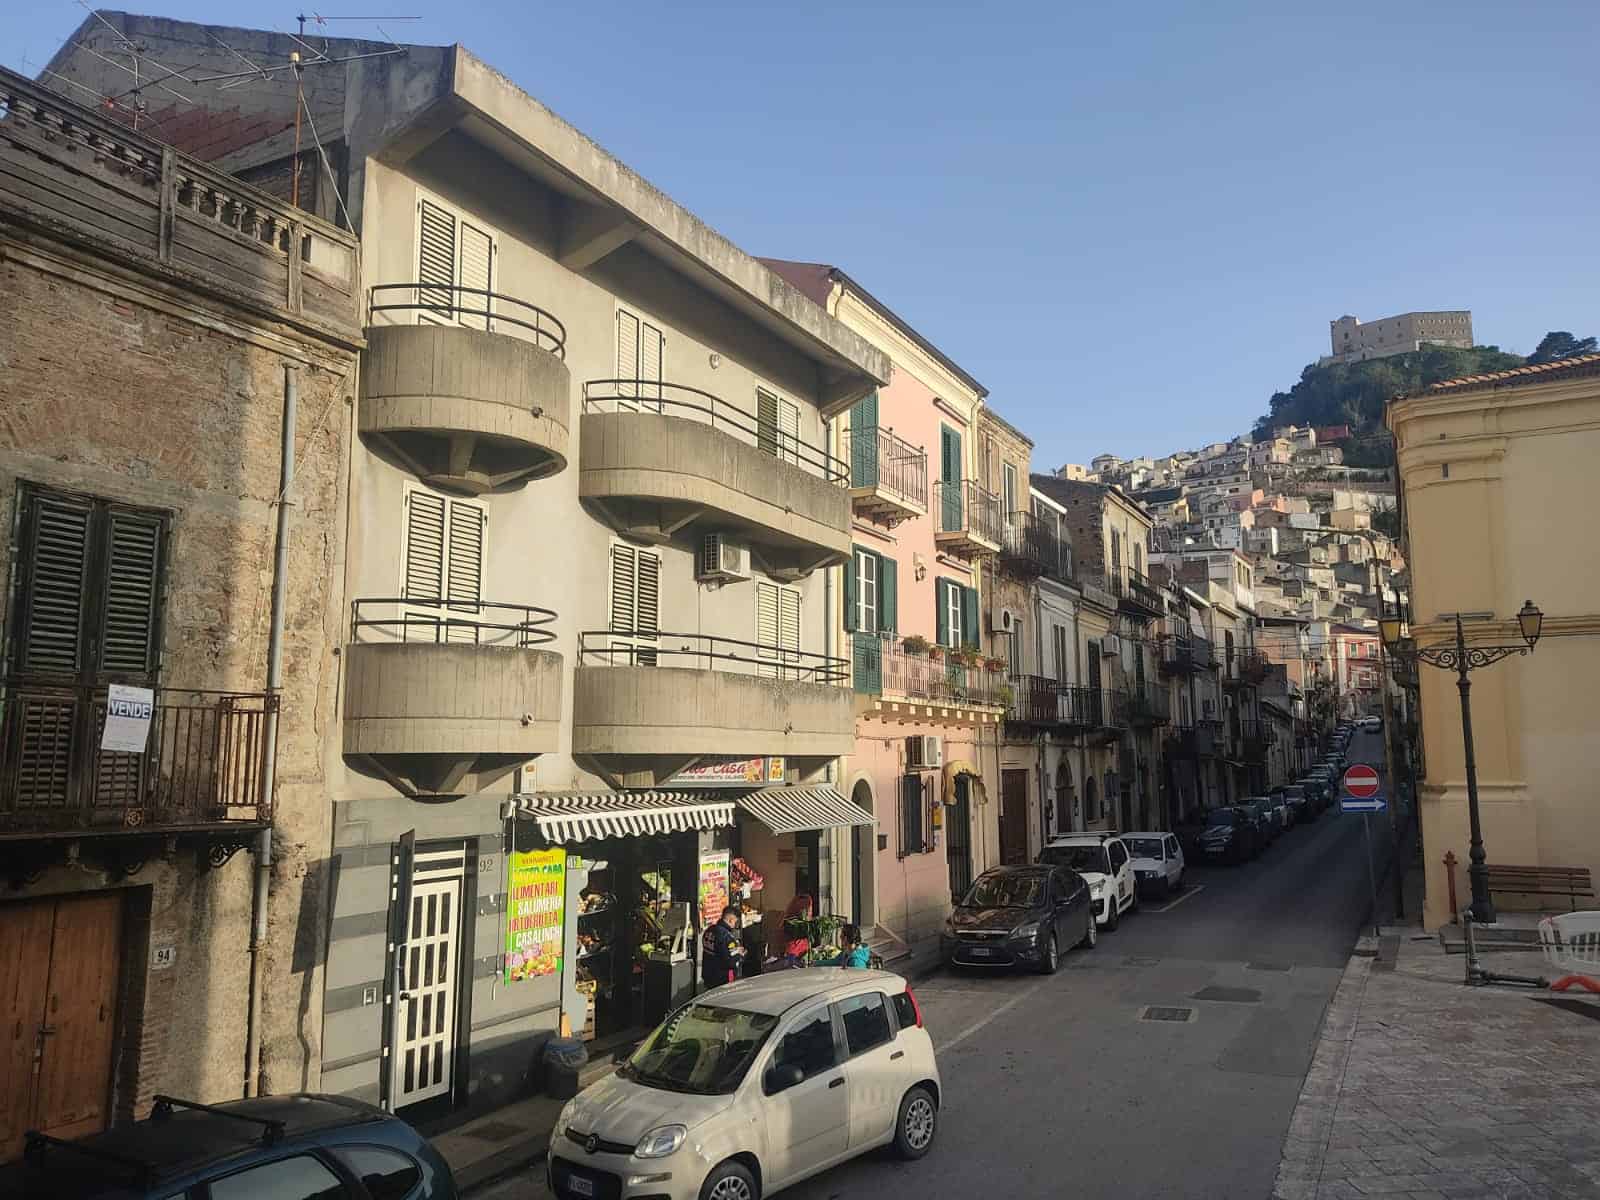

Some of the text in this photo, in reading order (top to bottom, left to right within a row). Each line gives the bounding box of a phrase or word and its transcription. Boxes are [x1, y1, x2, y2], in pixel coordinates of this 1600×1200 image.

[111, 700, 150, 718] VENDE
[479, 858, 493, 873] 92
[157, 948, 170, 962] 94
